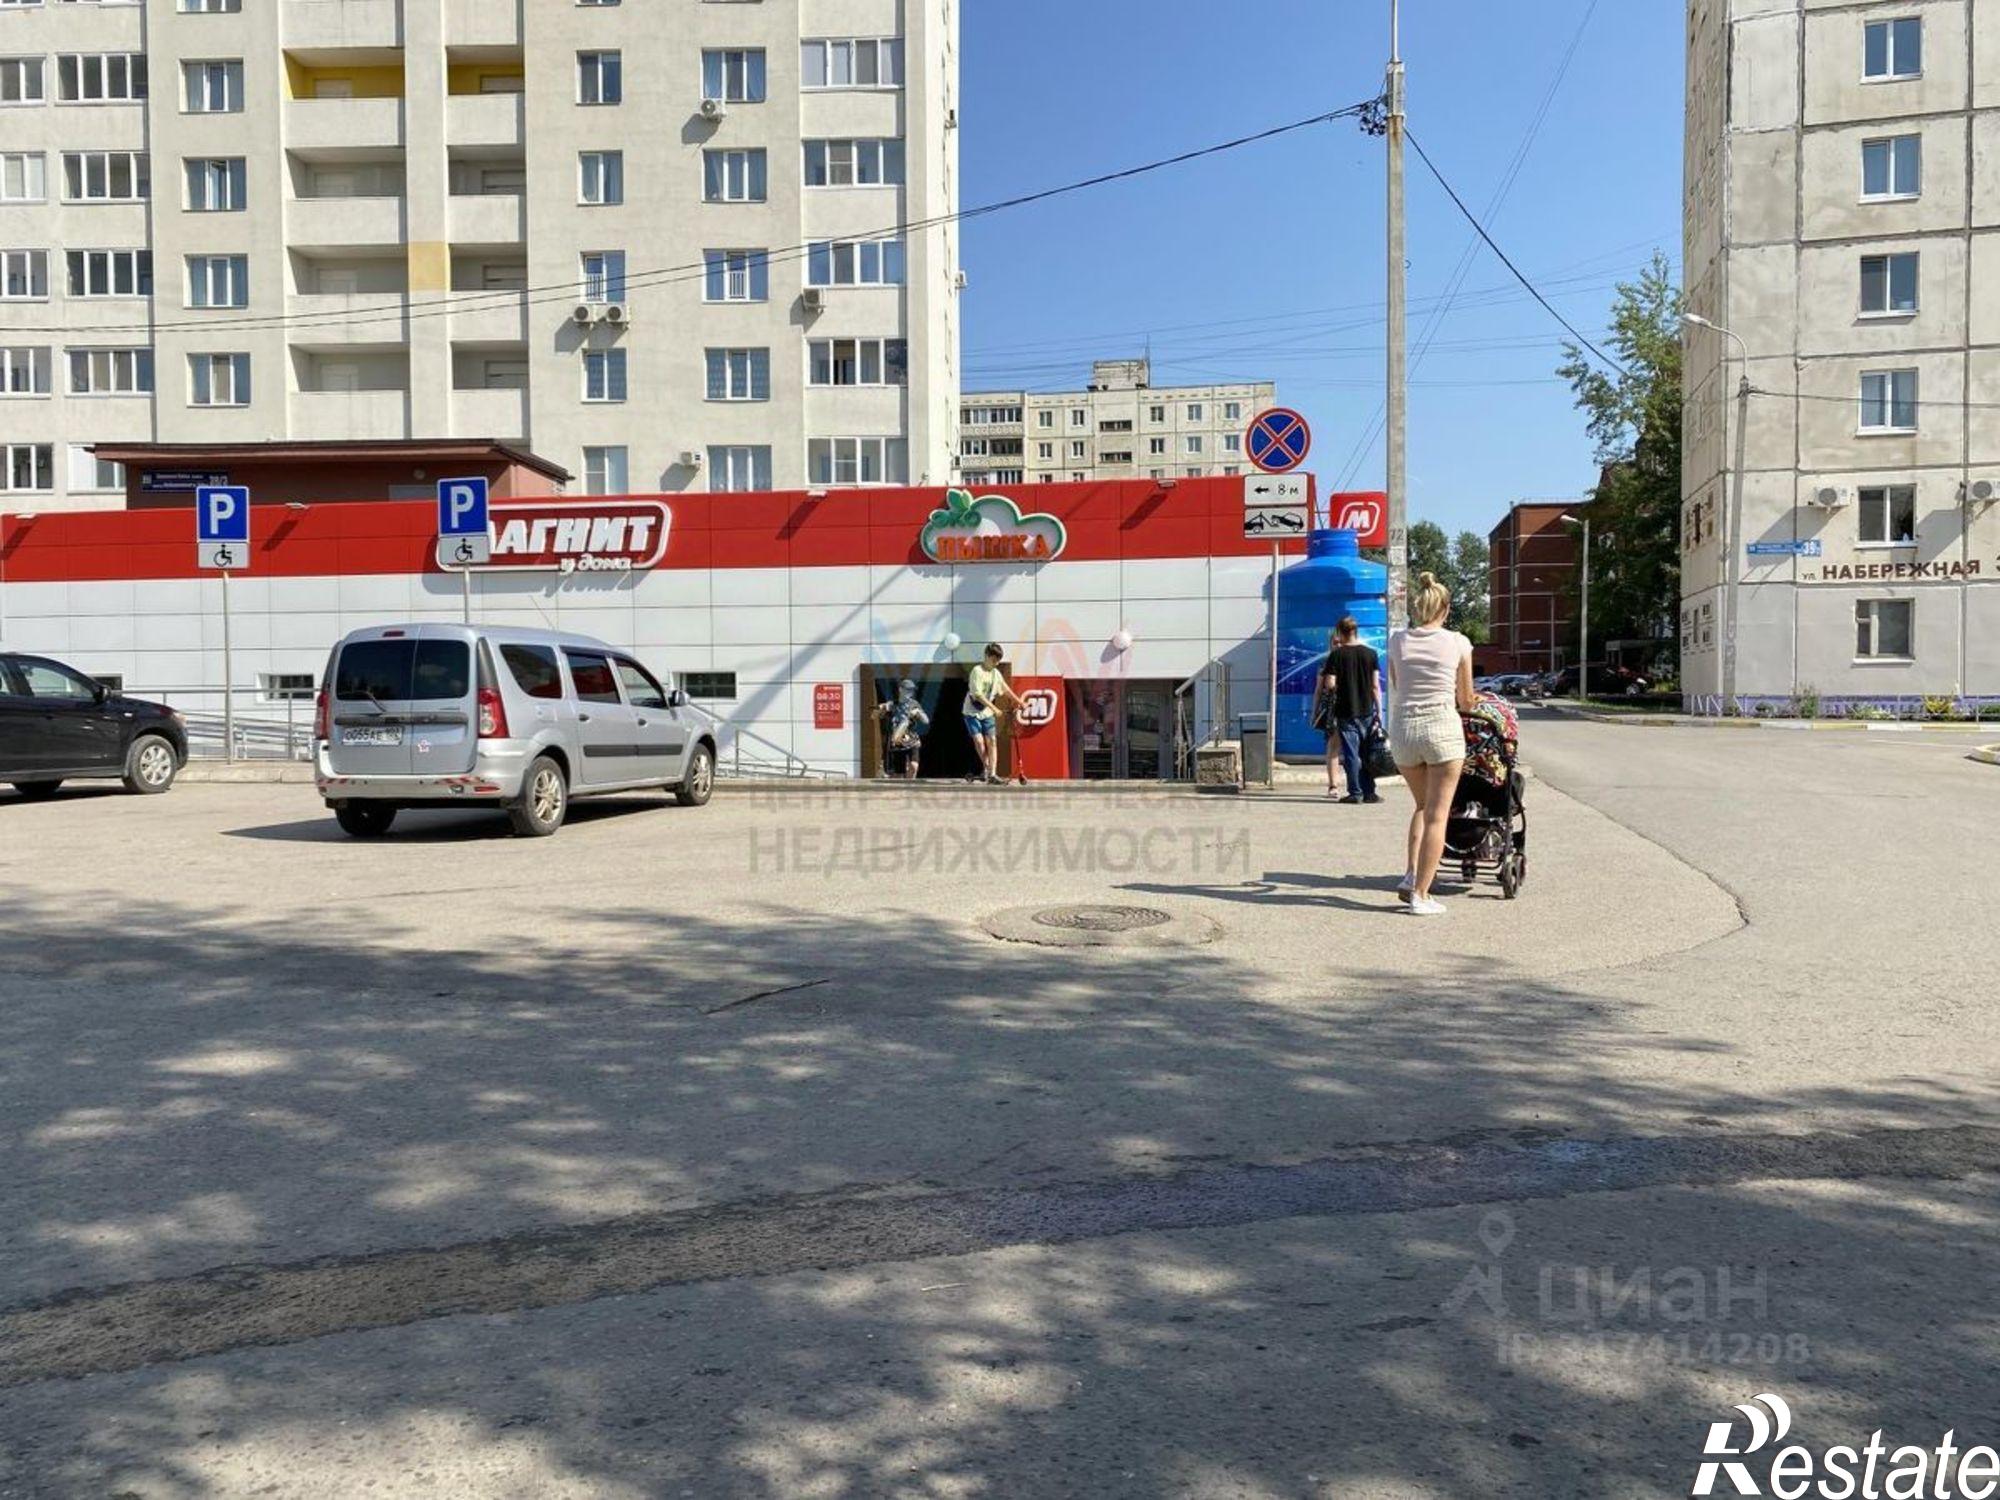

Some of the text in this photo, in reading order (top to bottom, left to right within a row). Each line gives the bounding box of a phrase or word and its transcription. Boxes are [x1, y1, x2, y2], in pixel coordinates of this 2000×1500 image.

[1277, 483, 1286, 496] 8
[209, 493, 235, 535] P
[451, 485, 475, 529] P
[936, 533, 1050, 561] ПЫШКА
[560, 552, 632, 576] у дома
[1822, 559, 1981, 581] НАБЕРЕЖНАЯ
